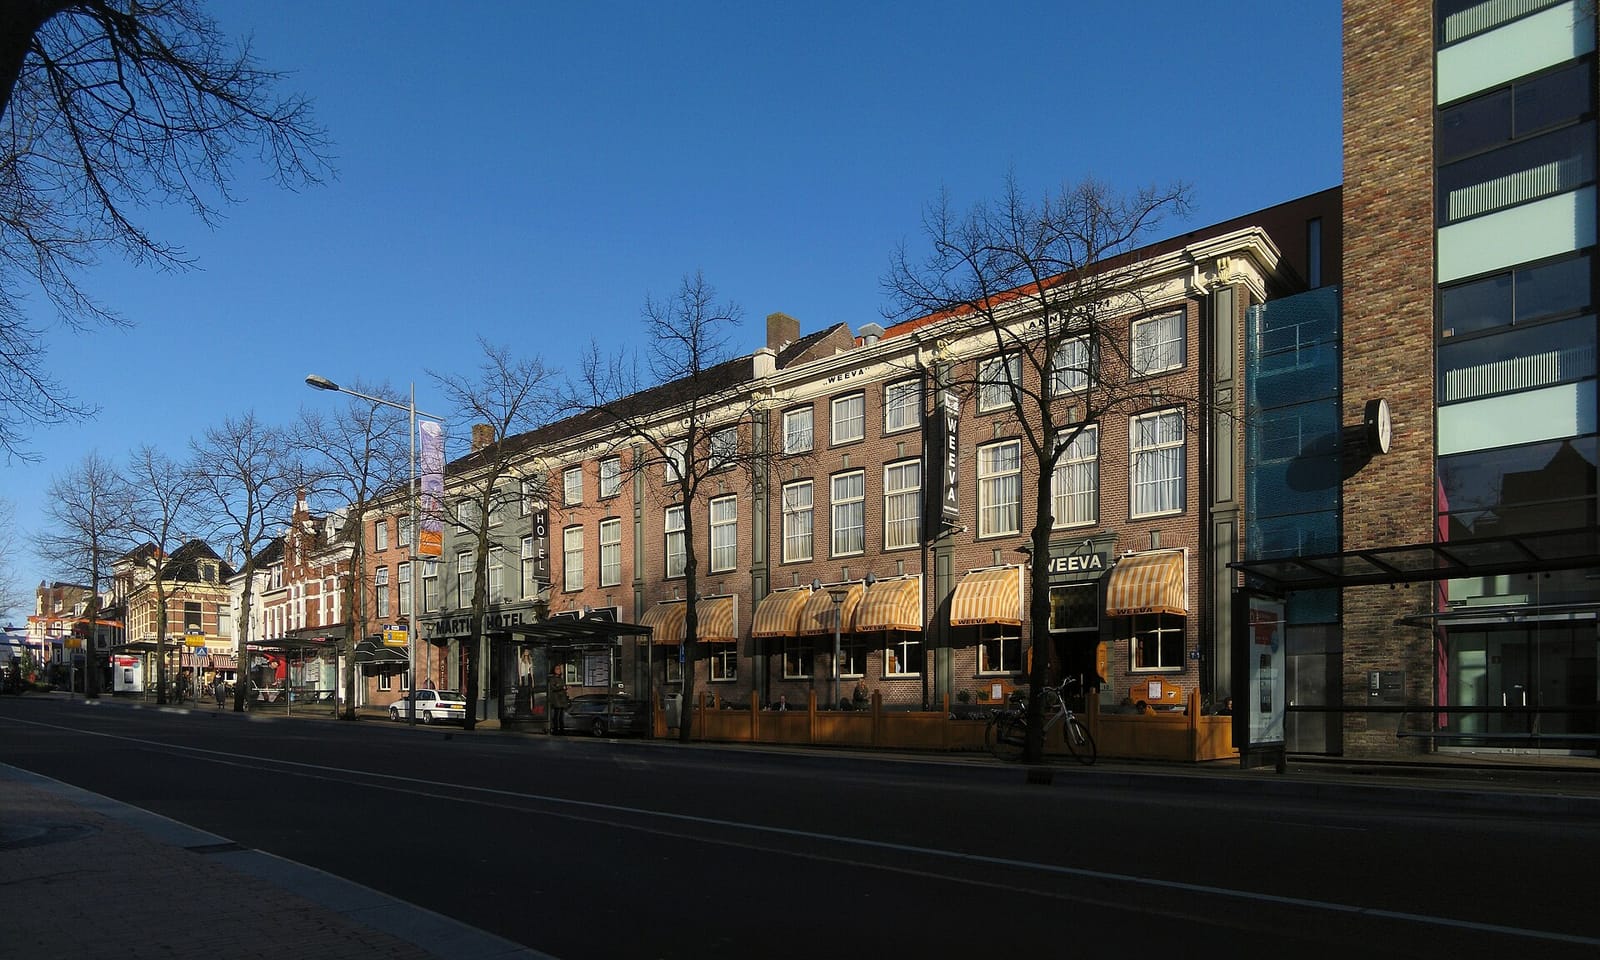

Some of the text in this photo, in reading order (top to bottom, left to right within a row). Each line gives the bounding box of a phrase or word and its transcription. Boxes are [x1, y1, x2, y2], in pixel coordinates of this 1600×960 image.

[947, 416, 958, 502] WEEVA
[536, 514, 545, 571] HOTEL
[436, 613, 523, 635] MARTI HOTEL
[1117, 607, 1153, 615] WEEVA
